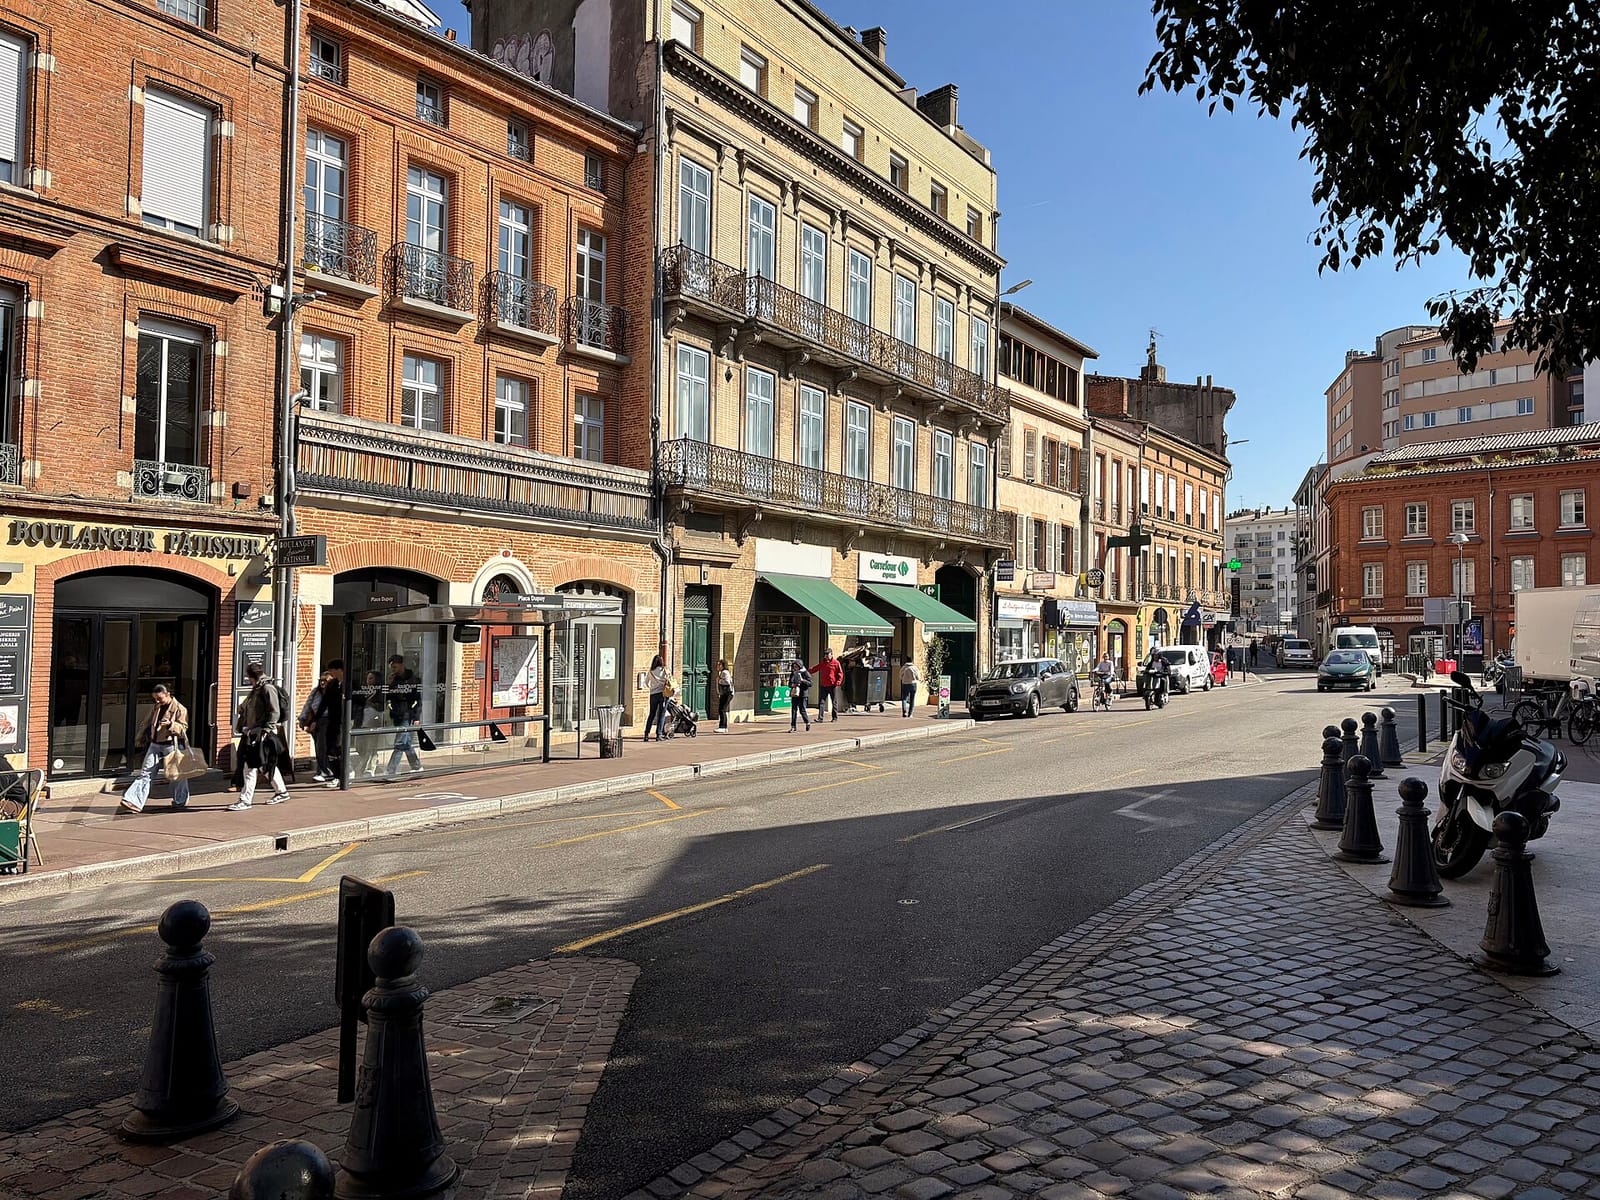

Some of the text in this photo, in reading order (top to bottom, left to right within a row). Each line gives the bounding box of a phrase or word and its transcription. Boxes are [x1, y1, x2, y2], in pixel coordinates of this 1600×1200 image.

[8, 520, 262, 559] BOULANGER PÂTISSIER
[280, 540, 315, 549] BOULANGER
[869, 559, 897, 571] Carrefour
[882, 572, 896, 580] express
